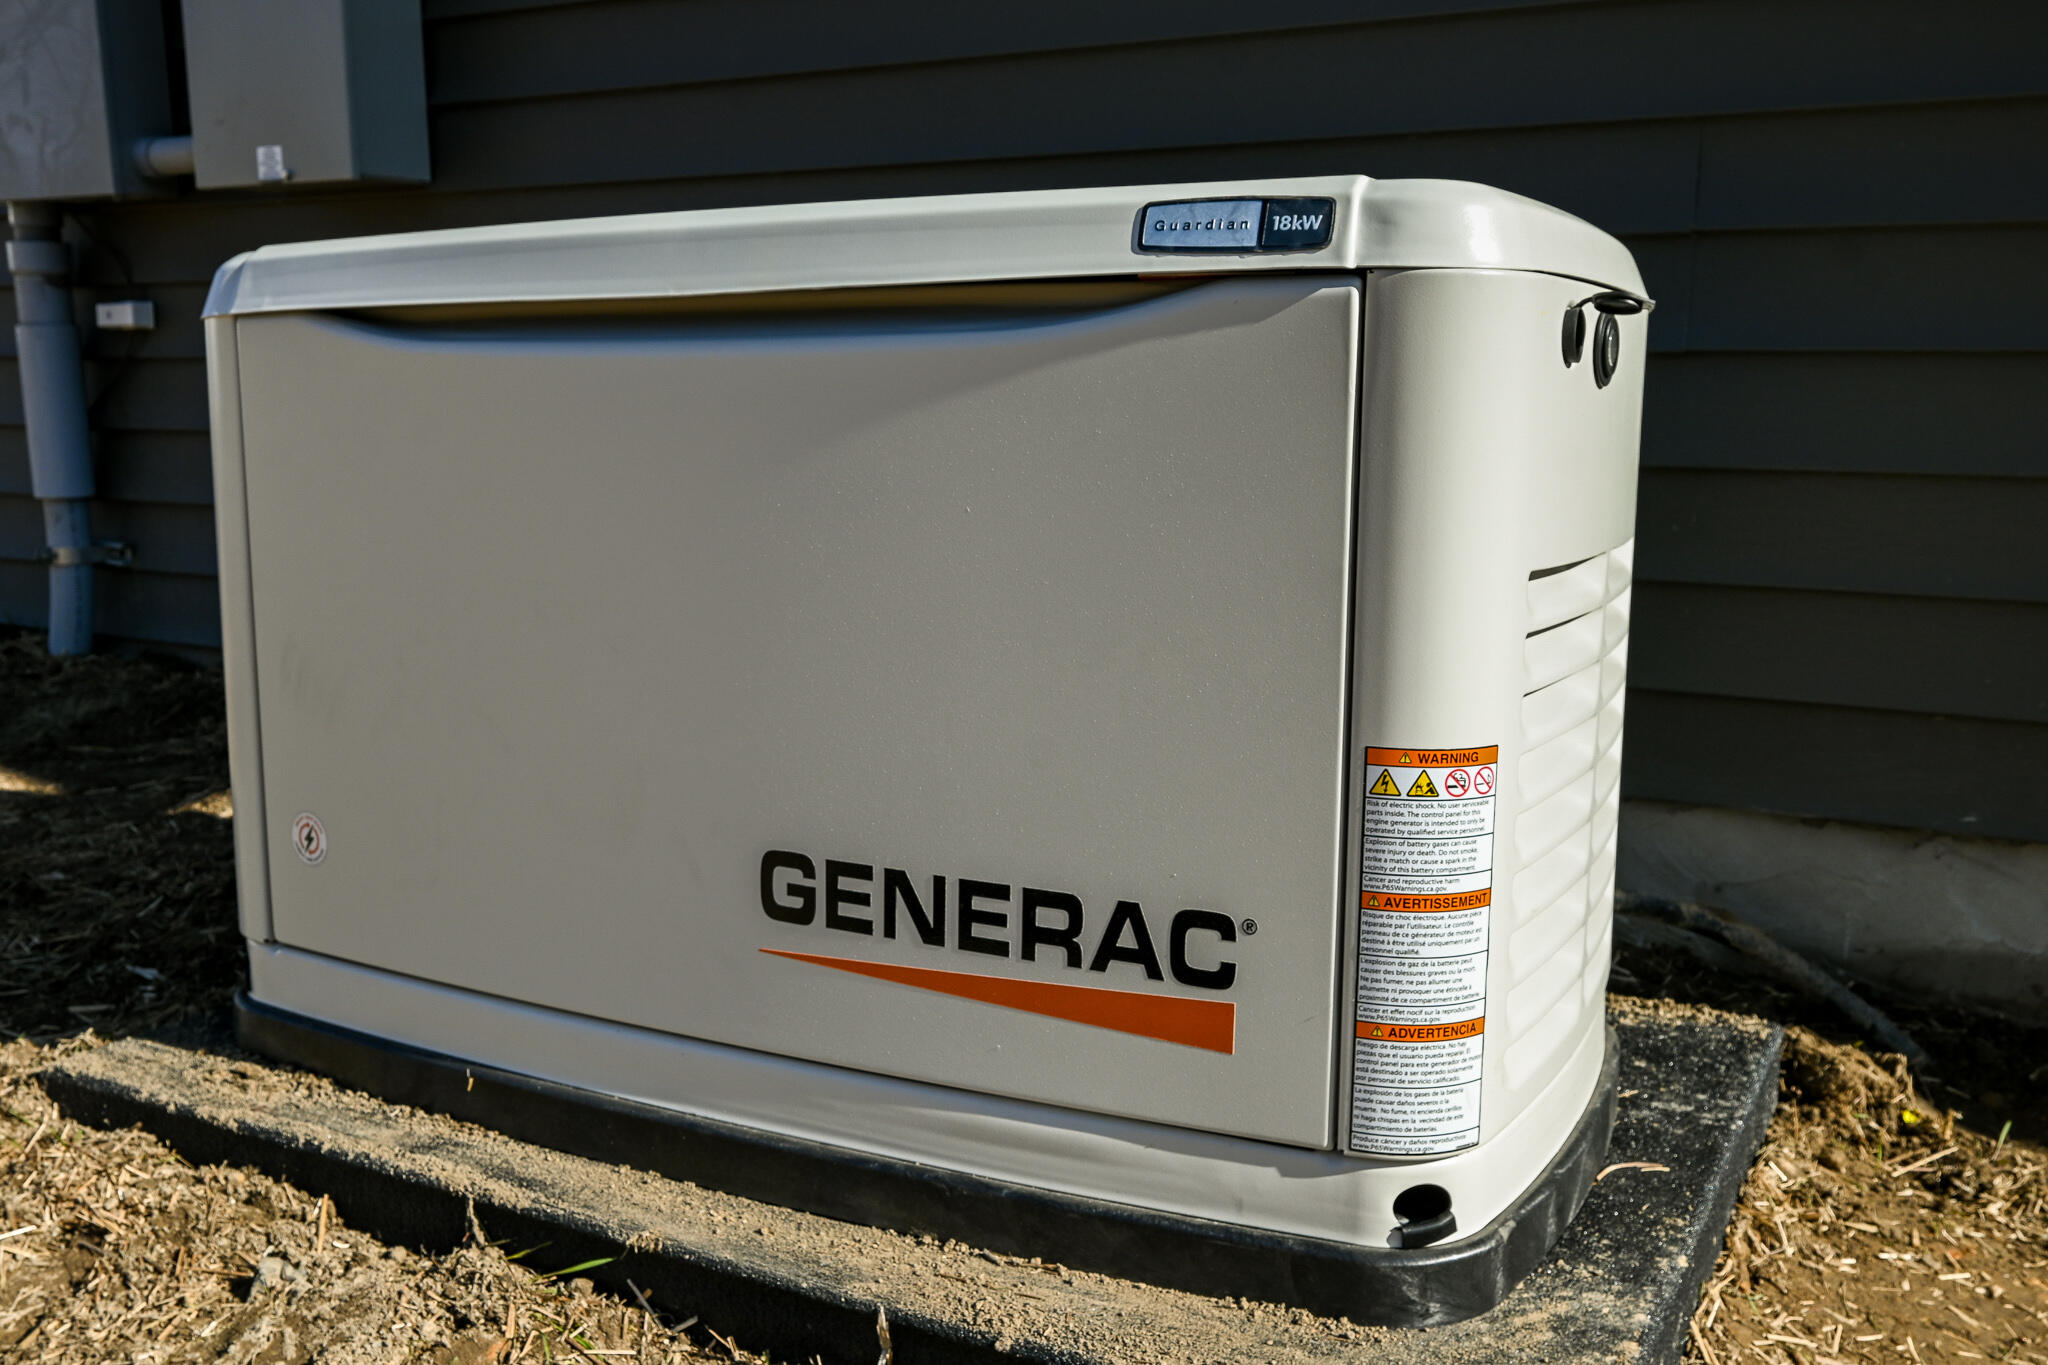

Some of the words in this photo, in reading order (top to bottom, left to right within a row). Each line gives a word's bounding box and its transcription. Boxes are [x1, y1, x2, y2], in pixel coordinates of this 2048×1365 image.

[1154, 219, 1250, 232] Guardian
[1272, 214, 1323, 232] 18kW
[1418, 752, 1478, 764] WARNING
[1365, 838, 1397, 846] Explosion
[1364, 875, 1386, 883] Cancer
[1384, 893, 1488, 909] AVERTISSEMENT
[1388, 1022, 1476, 1038] ADVERTENCIA
